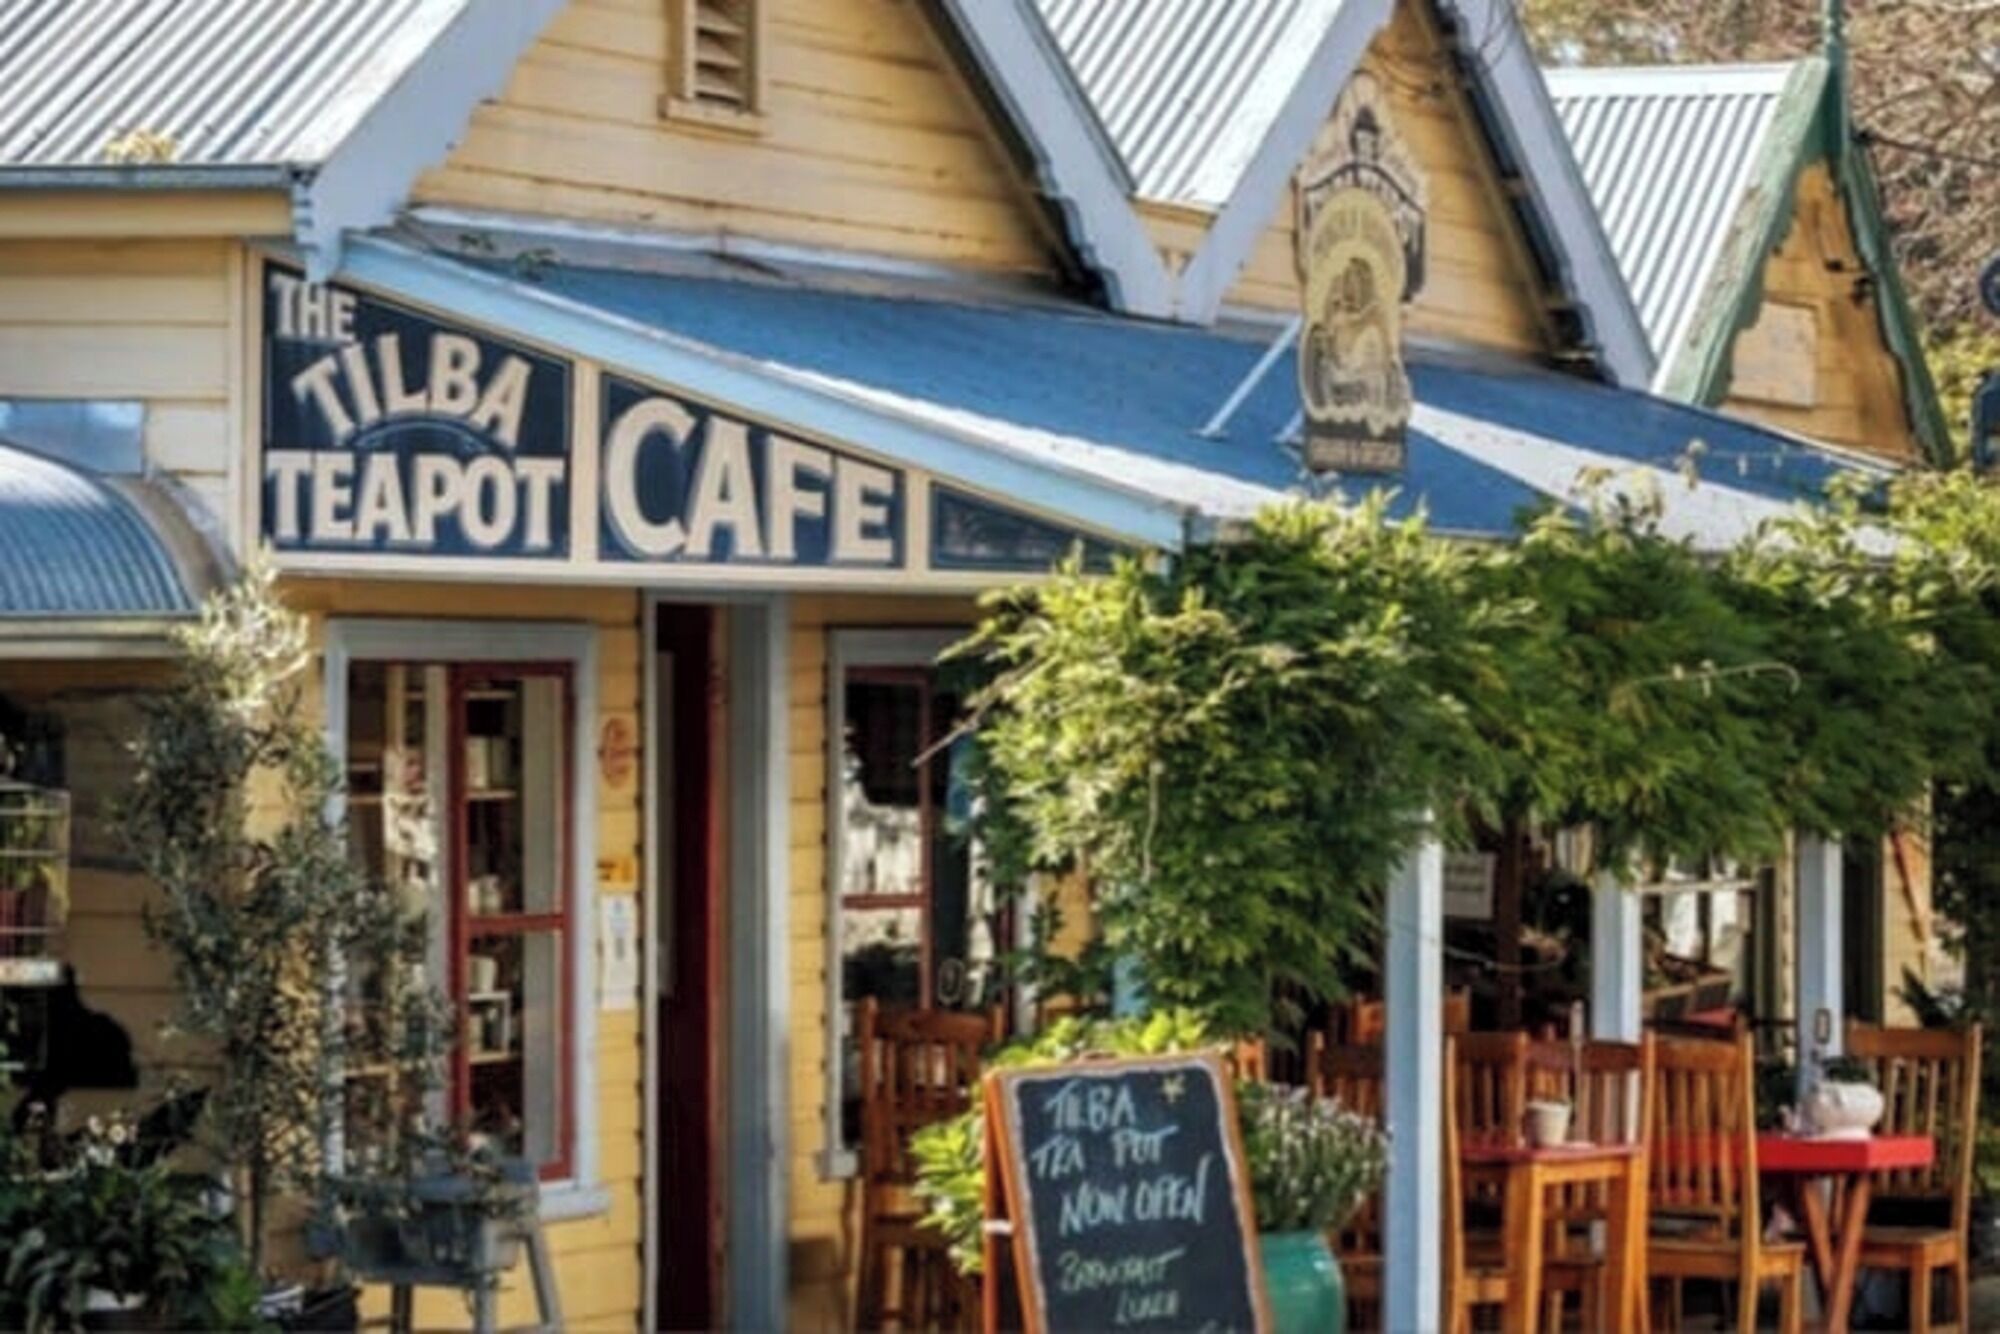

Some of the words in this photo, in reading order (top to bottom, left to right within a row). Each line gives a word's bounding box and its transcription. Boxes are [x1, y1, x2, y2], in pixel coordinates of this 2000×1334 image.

[272, 274, 355, 342] THE
[292, 332, 532, 448] TILBA
[266, 451, 564, 548] TEAPOT
[605, 398, 894, 561] CAFE
[1044, 1081, 1136, 1131] TILBA
[1111, 1126, 1178, 1167] POT
[1060, 1184, 1129, 1236] NOW
[1135, 1154, 1213, 1223] OPEN
